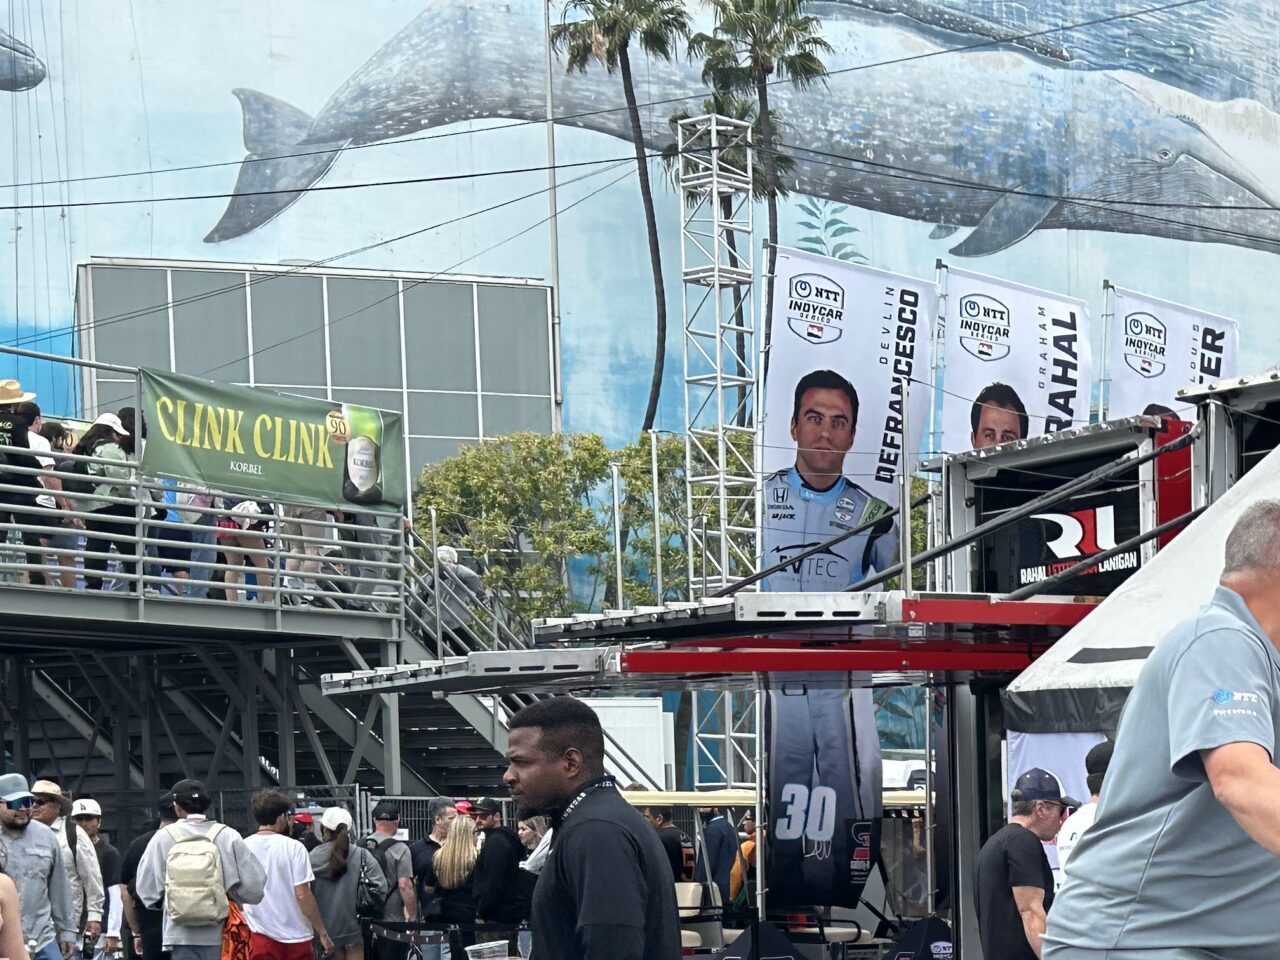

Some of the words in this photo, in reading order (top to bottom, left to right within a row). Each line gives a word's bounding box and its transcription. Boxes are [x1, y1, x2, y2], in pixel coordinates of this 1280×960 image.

[815, 287, 840, 303] NTT
[788, 299, 843, 321] INDYCAR
[983, 306, 1006, 321] NTT
[879, 286, 895, 365] DEVLIN
[960, 319, 1010, 338] INDYCAR
[1145, 324, 1163, 339] NTT
[1038, 306, 1048, 389] GRAHAM
[1125, 336, 1166, 357] INDYCAR
[1189, 324, 1200, 383] LOUIS
[875, 288, 919, 484] DEFRANCESCO
[1044, 311, 1078, 435] RAHAL
[156, 395, 245, 455] CLINK
[253, 414, 334, 469] CLINK
[330, 418, 347, 436] 90
[230, 461, 263, 475] KORBEL
[1020, 565, 1048, 584] RAHAL
[1098, 551, 1137, 573] LANIGAN
[775, 783, 836, 841] 30
